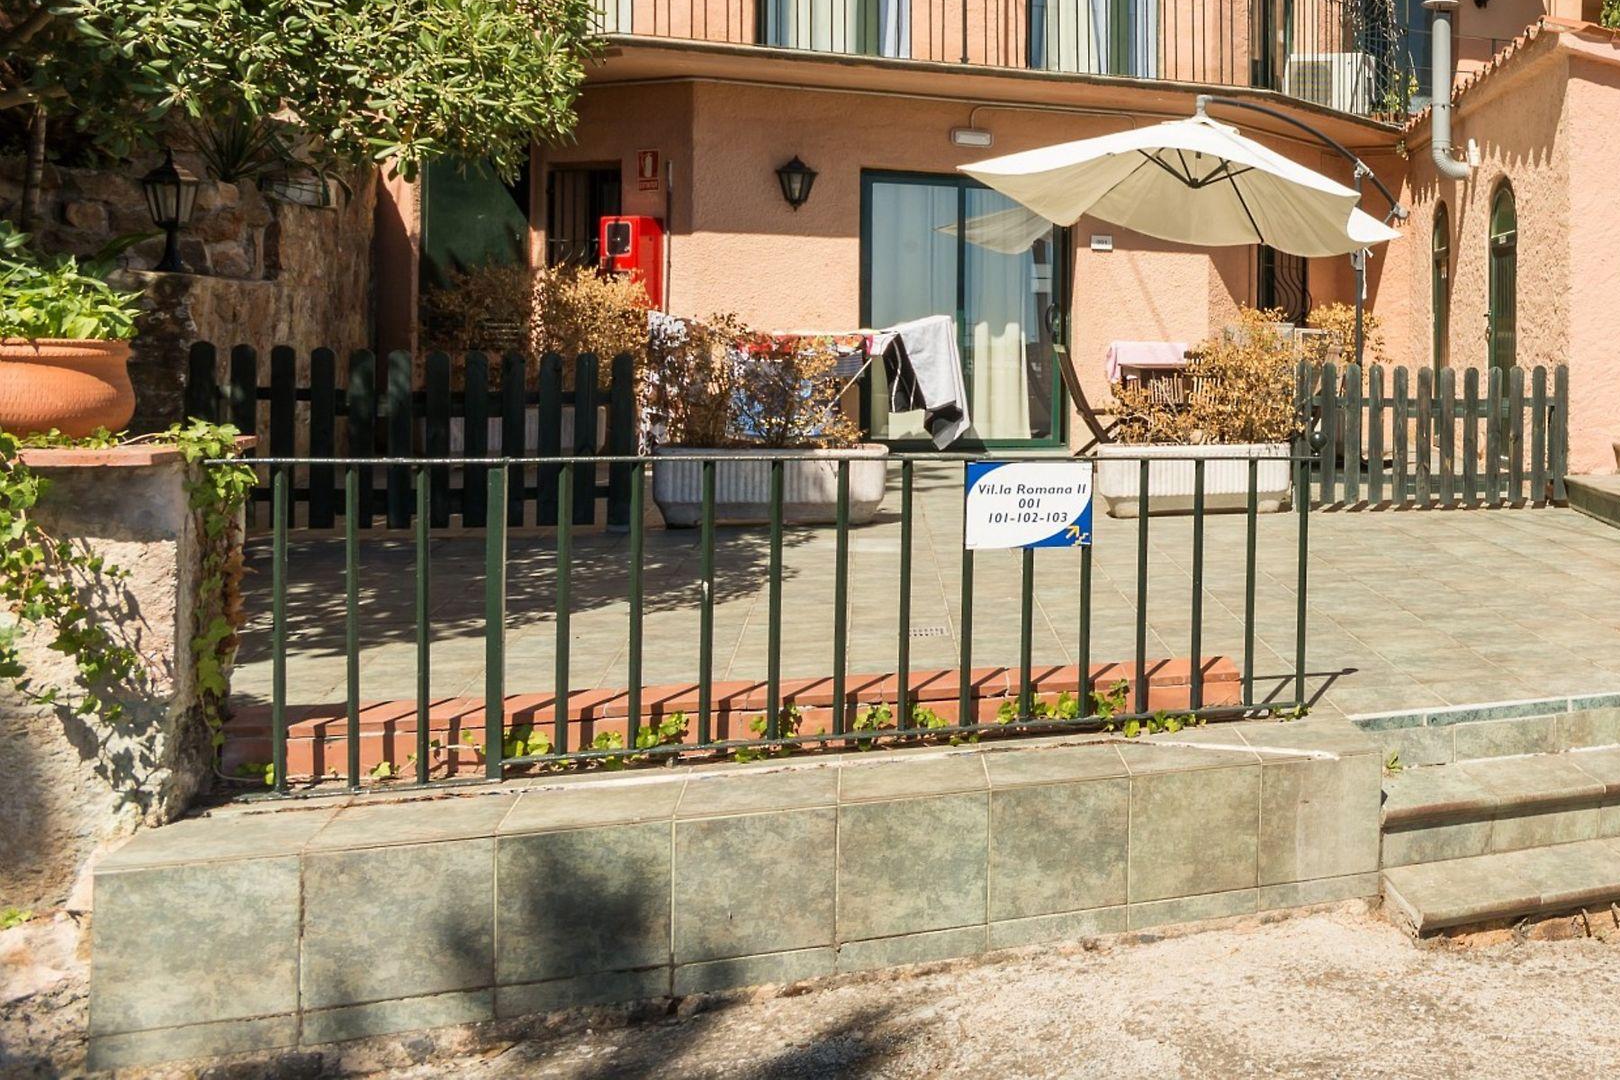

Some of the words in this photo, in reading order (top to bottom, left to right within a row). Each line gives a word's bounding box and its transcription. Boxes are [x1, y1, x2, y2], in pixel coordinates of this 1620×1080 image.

[978, 483, 1012, 495] Vil.la
[1016, 483, 1073, 495] Romana
[1077, 483, 1087, 494] II
[1018, 498, 1041, 509] 001
[988, 512, 1069, 524] 101-102-103
